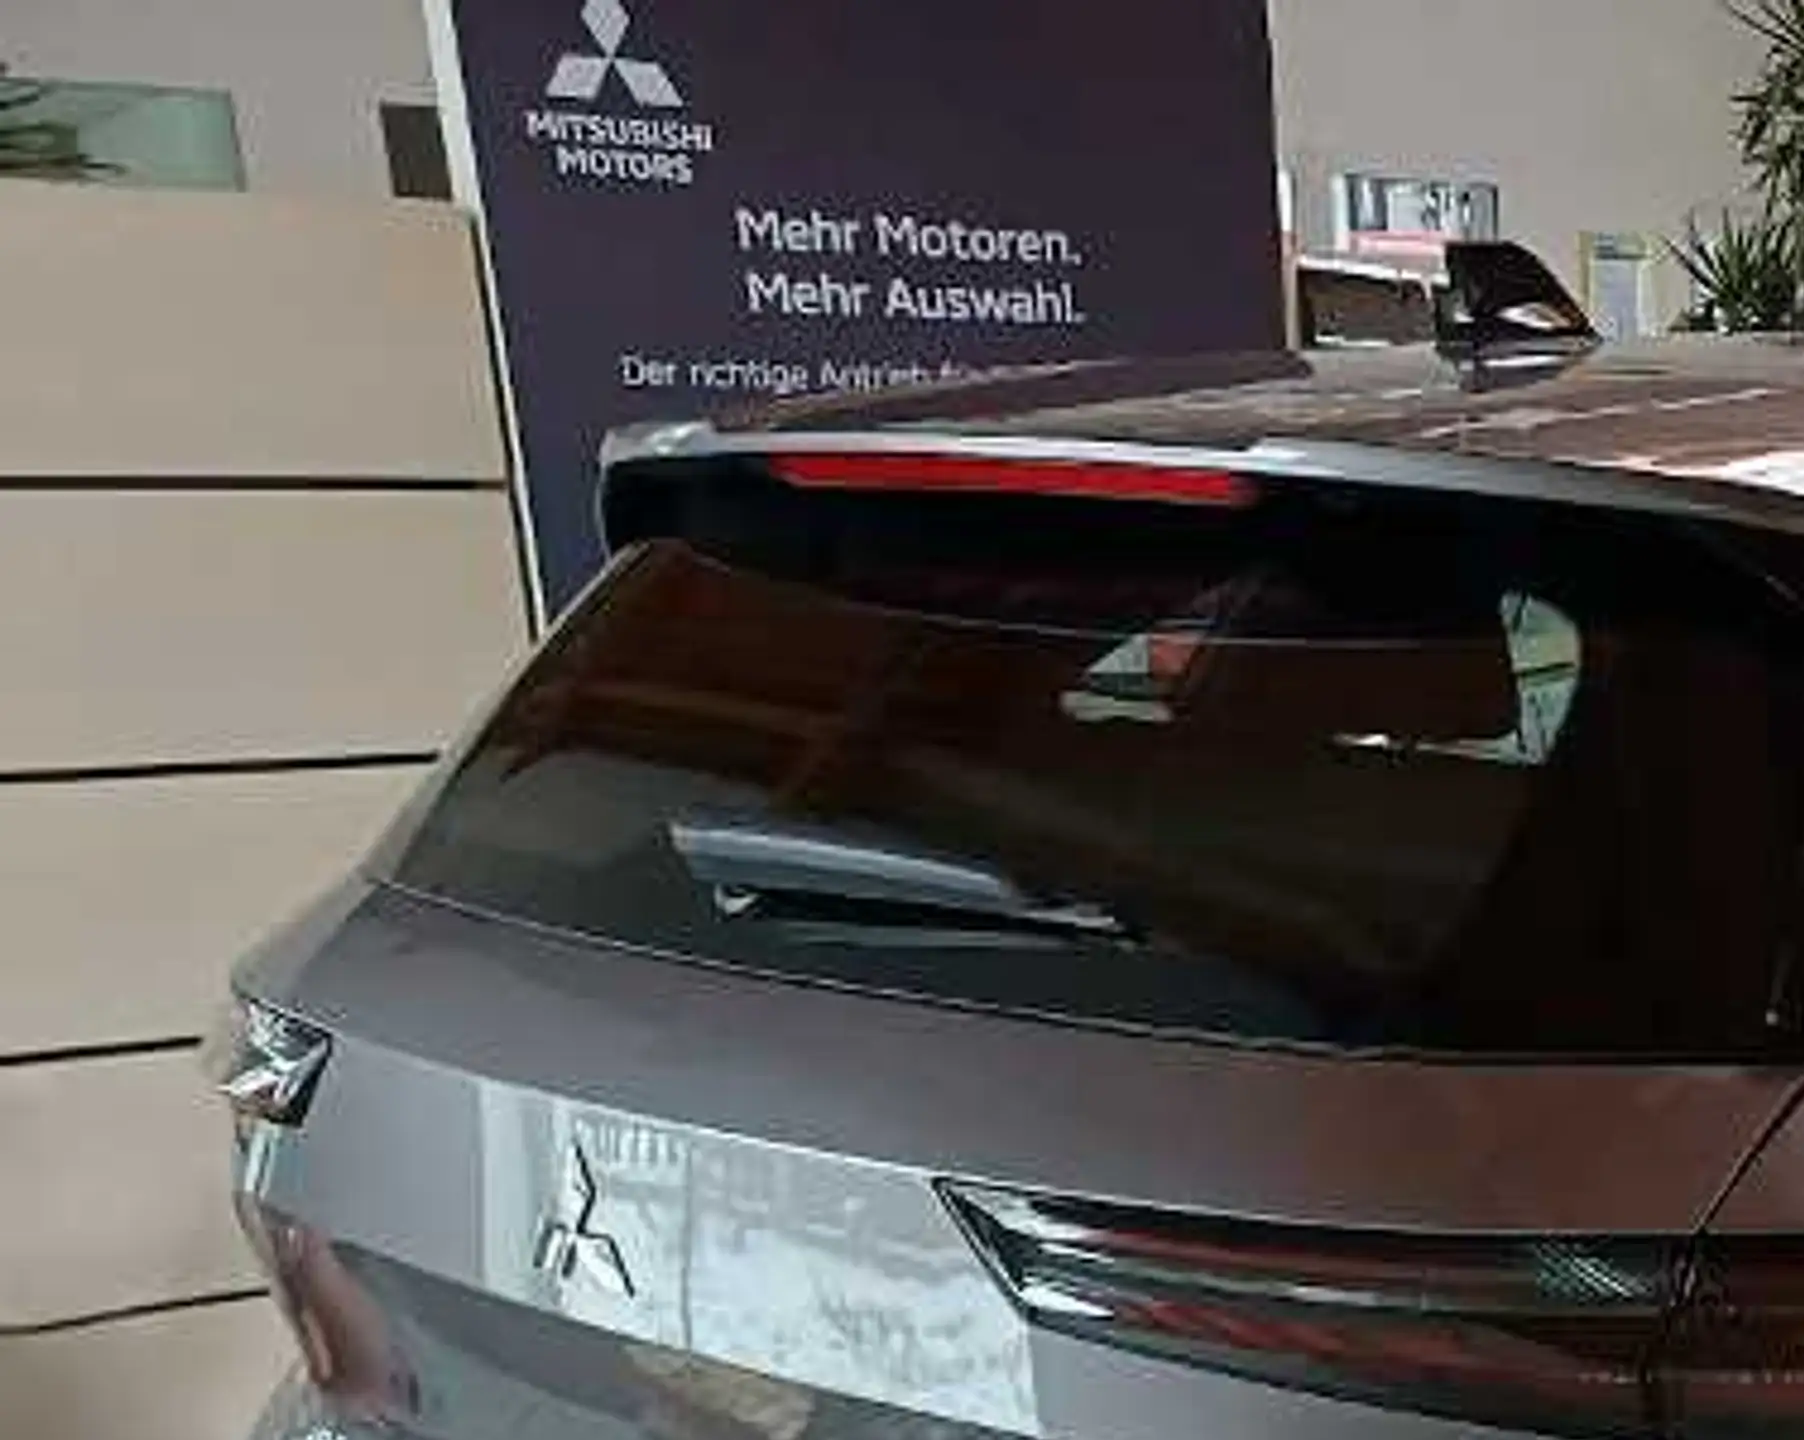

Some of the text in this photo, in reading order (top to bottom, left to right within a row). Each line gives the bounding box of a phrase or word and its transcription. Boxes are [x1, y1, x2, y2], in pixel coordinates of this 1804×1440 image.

[525, 109, 713, 151] MITSUBISHI
[557, 144, 693, 183] MOTORS
[735, 208, 1082, 265] Mehr Motoren.
[747, 271, 1086, 324] Mehr Auswahl.
[622, 354, 676, 387] Der
[690, 357, 809, 395] richtige
